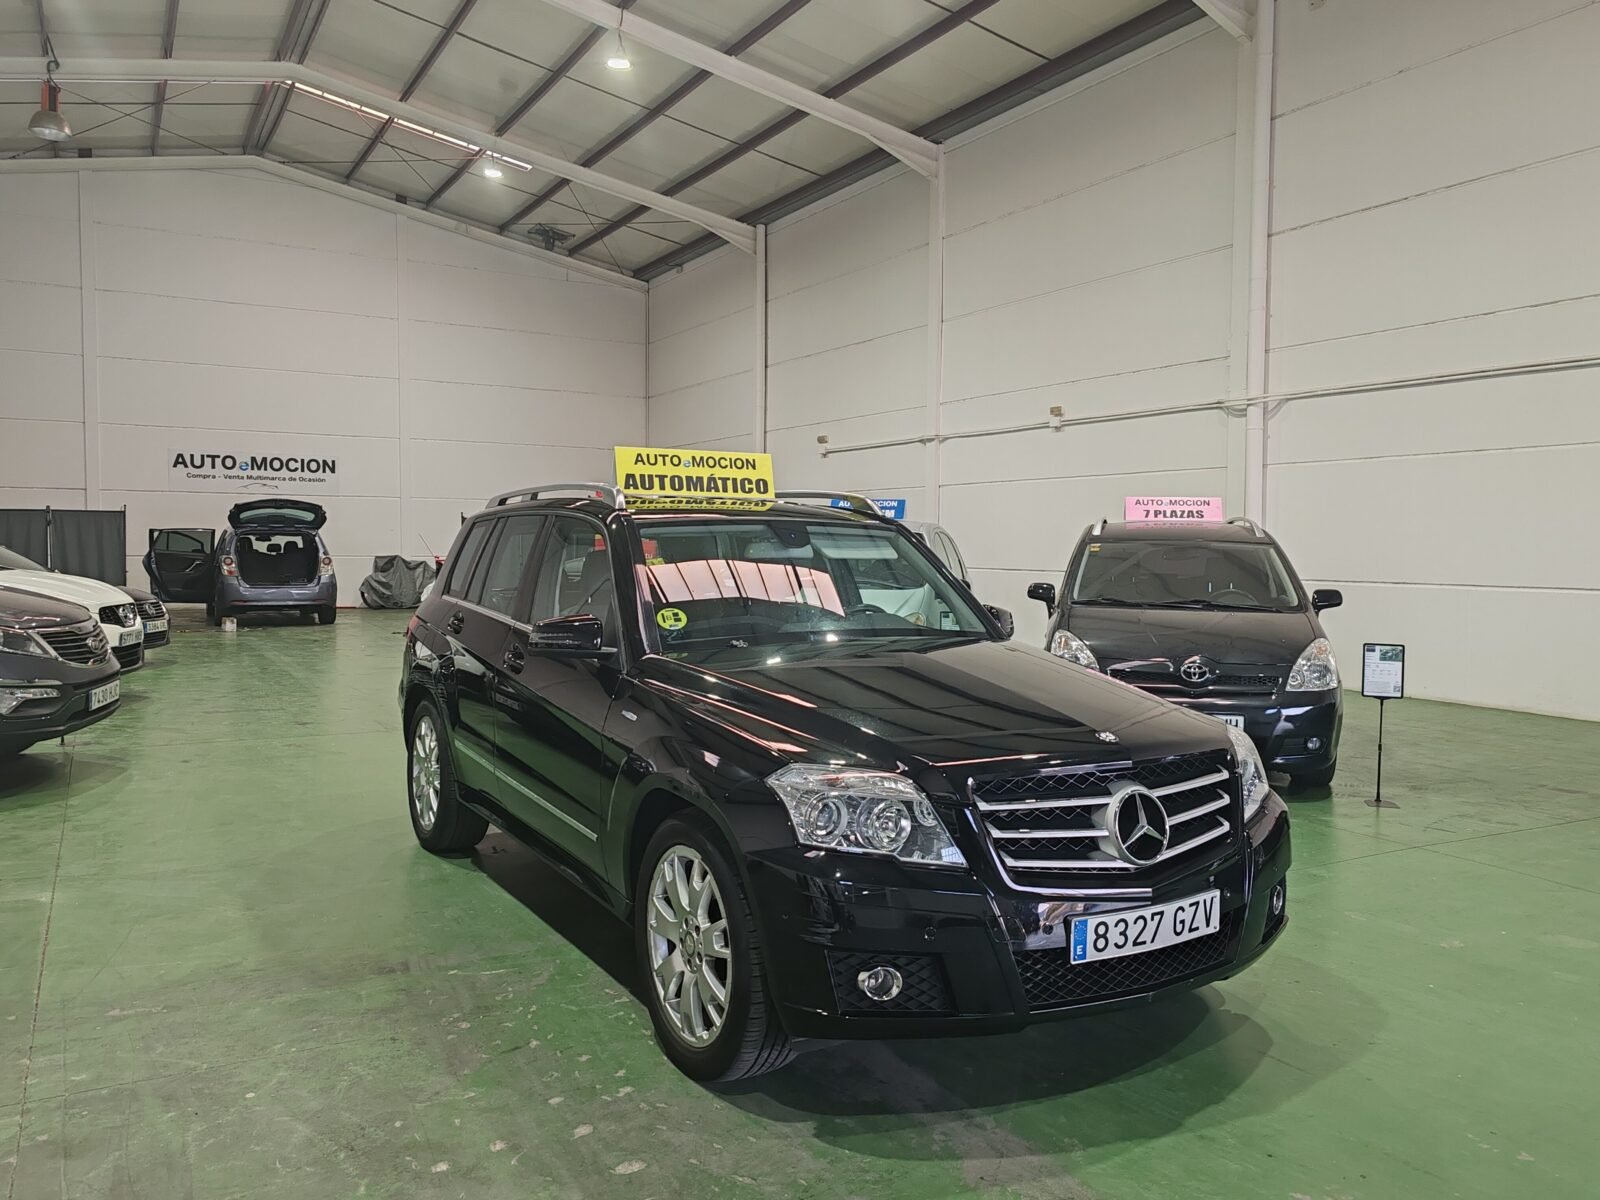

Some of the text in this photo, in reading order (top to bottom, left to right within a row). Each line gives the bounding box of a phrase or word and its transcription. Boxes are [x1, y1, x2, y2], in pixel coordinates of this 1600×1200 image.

[186, 472, 217, 480] Compra
[246, 474, 287, 482] Multimarca
[624, 473, 769, 495] AUTOMÁTICO
[1143, 509, 1205, 519] 7 PLAZAS
[93, 687, 109, 708] 7430
[1076, 896, 1217, 956] E 8327 GZV
